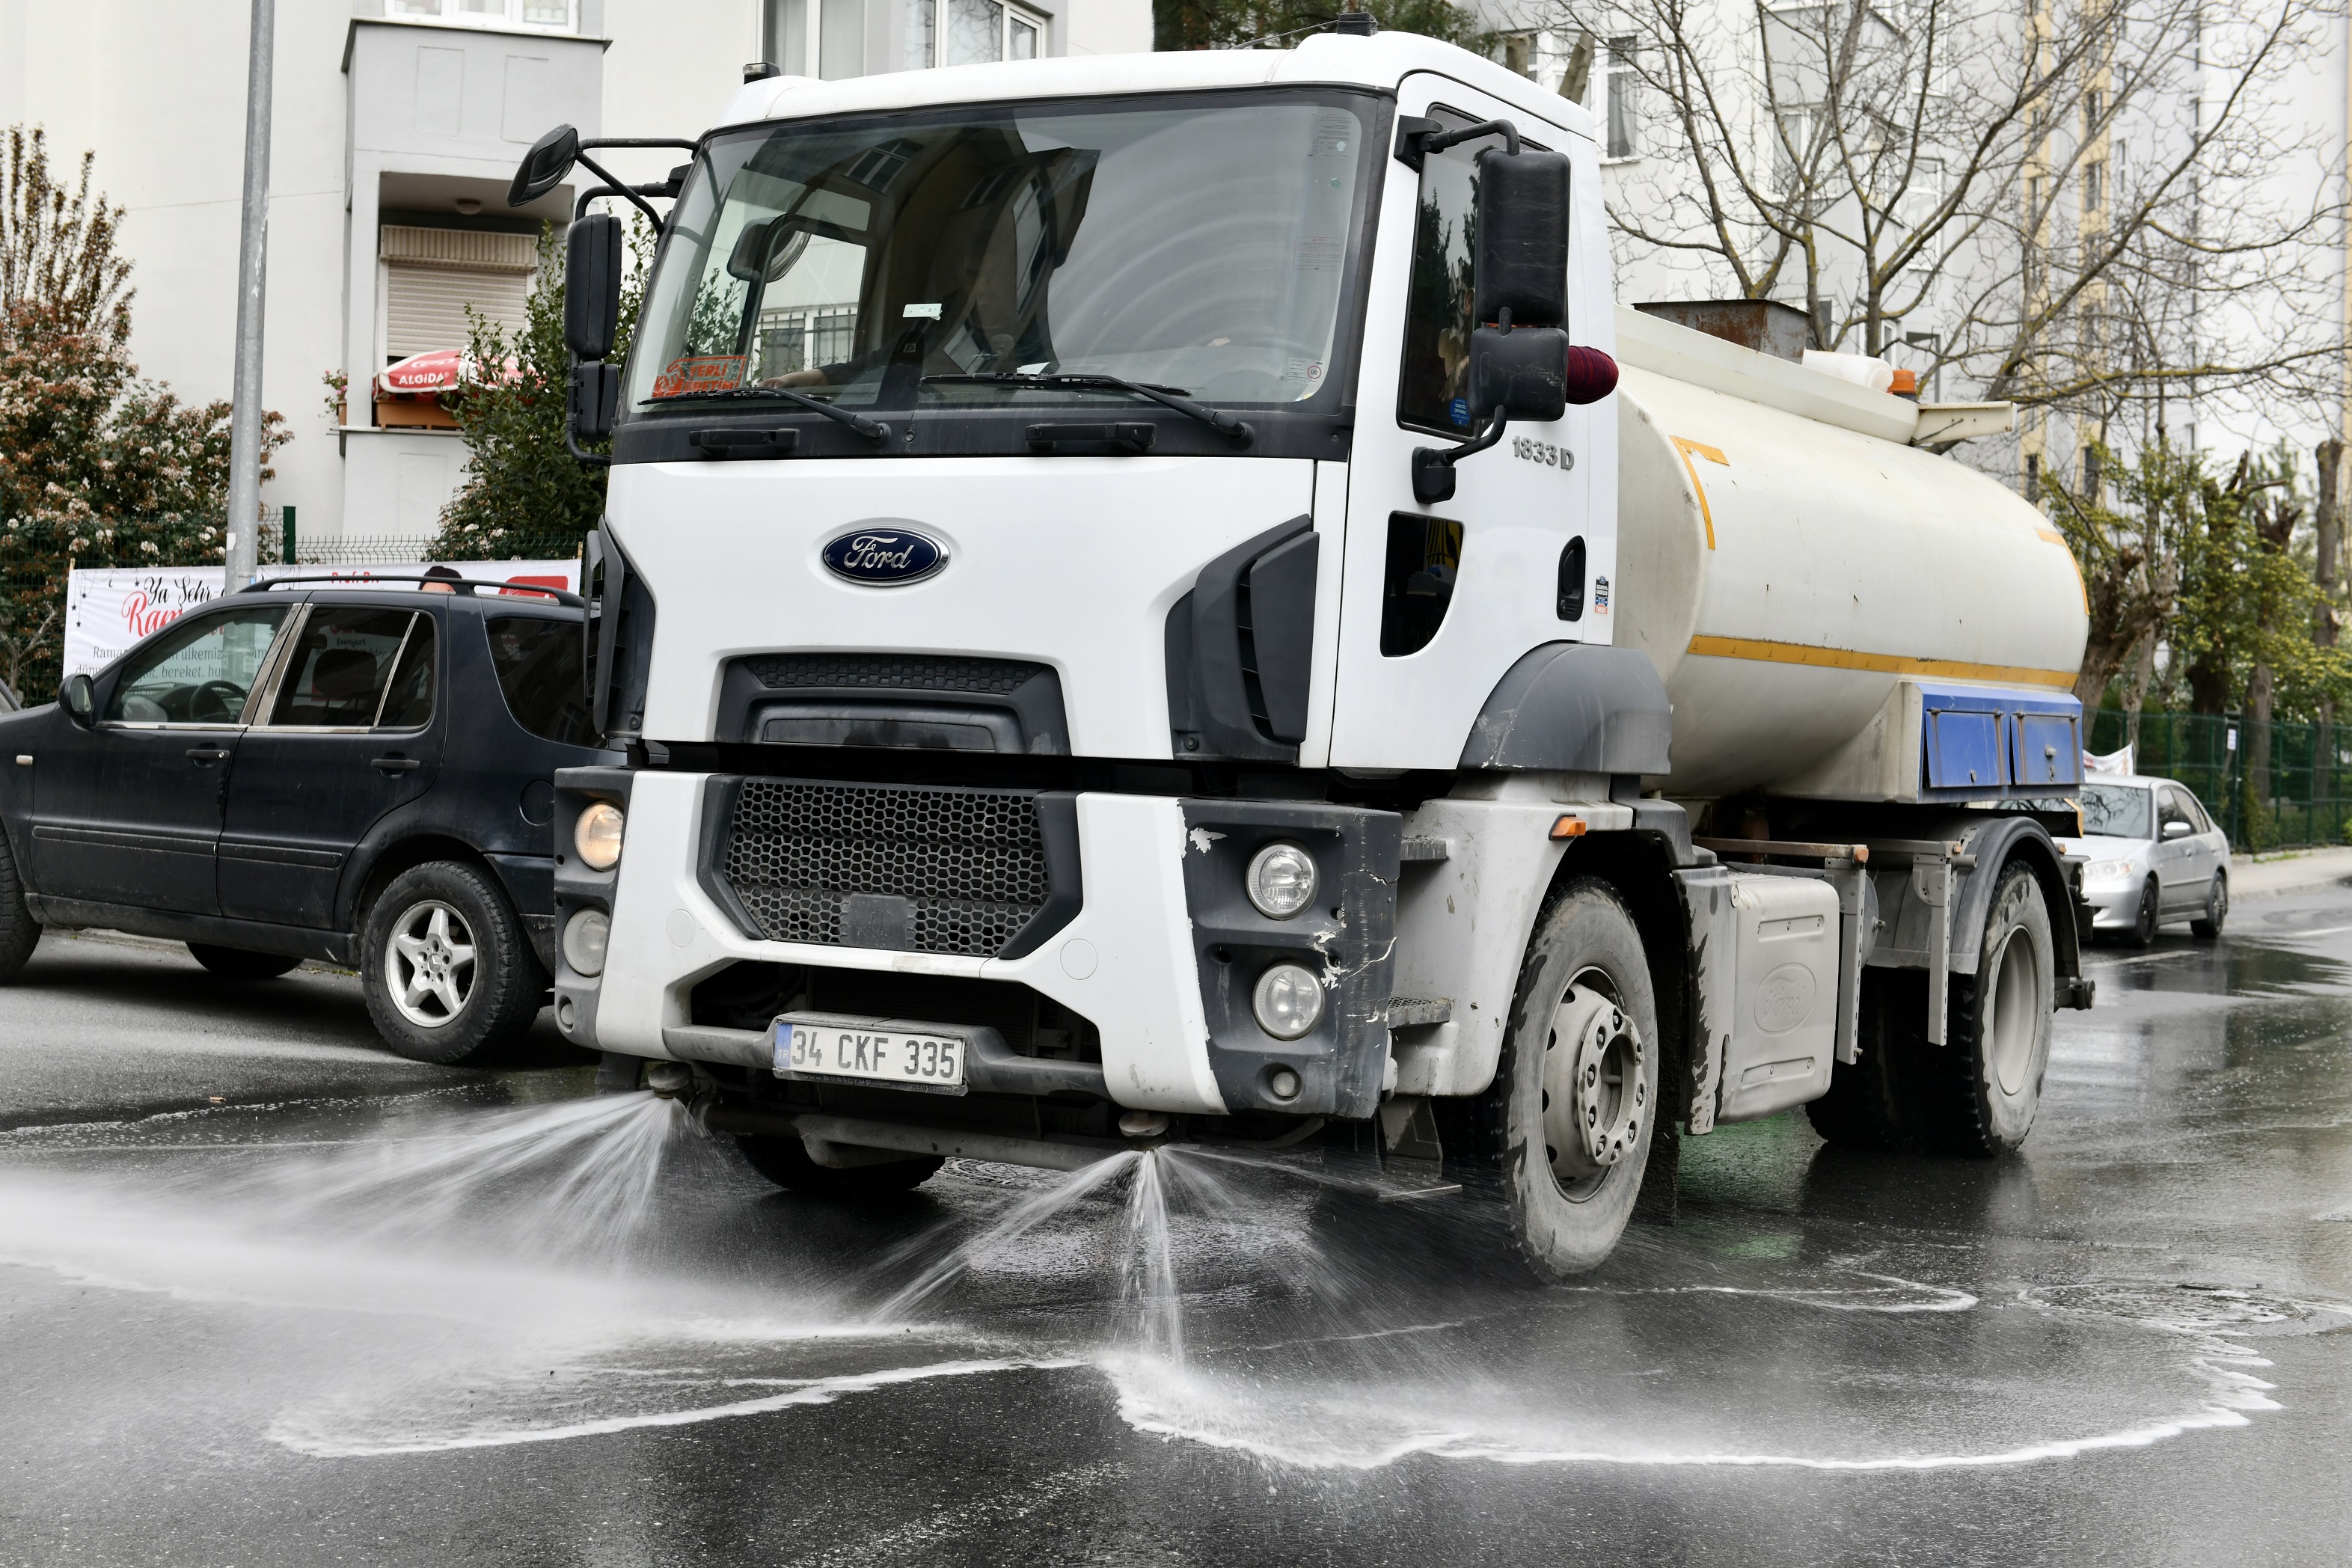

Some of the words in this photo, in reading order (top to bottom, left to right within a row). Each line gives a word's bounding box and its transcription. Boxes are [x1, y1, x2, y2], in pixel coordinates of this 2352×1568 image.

[689, 362, 728, 377] YERLİ
[684, 377, 734, 392] ÜRETİM
[1512, 435, 1558, 467] 1833
[1560, 447, 1575, 471] D
[843, 536, 914, 569] Ford
[144, 576, 169, 606] Ya
[183, 647, 222, 659] ülkemiz
[337, 638, 366, 648] Esenyurt
[162, 666, 204, 679] bereket,
[1763, 977, 1806, 1020] Ford
[778, 1049, 788, 1059] TR
[791, 1030, 822, 1066] 34
[838, 1034, 889, 1071] CKF
[904, 1040, 955, 1078] 335
